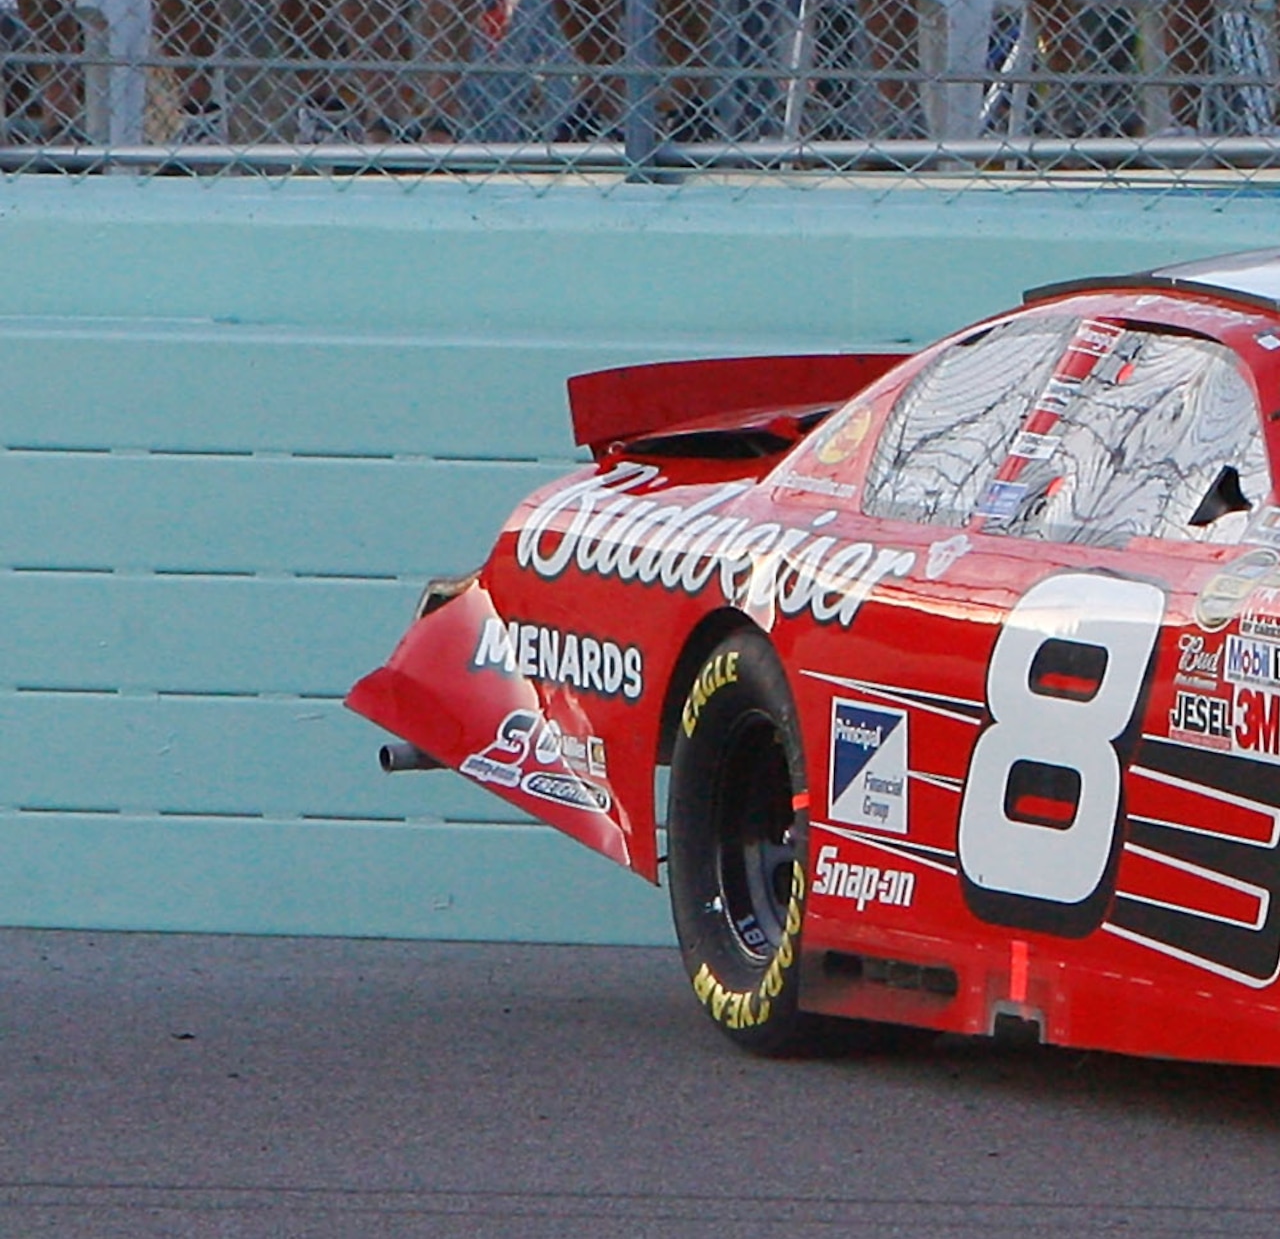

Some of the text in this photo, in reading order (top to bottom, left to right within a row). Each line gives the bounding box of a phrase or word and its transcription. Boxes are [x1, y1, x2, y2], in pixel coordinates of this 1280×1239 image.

[515, 462, 915, 627] Budweiser
[473, 617, 644, 700] MENARDS
[1228, 636, 1270, 679] Mobil
[957, 573, 1166, 904] 8
[1171, 693, 1232, 738] JESEL
[862, 795, 890, 823] Group
[811, 845, 915, 911] Snap-on
